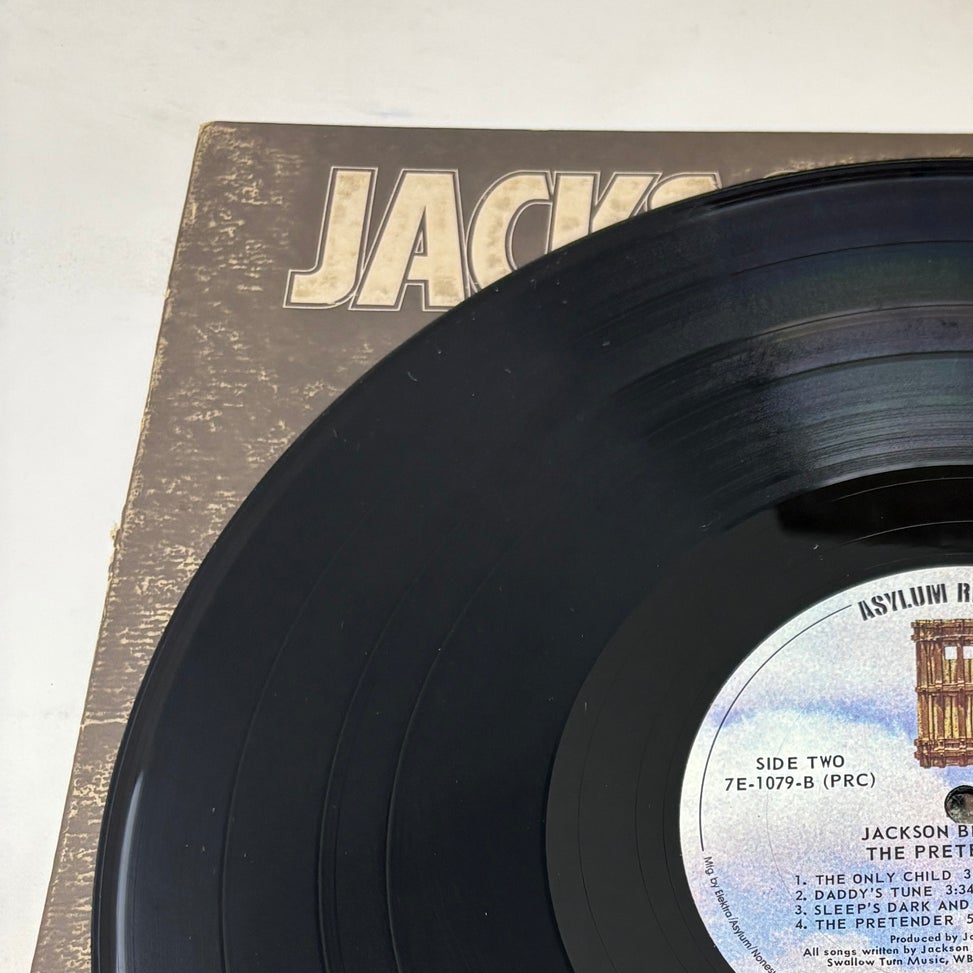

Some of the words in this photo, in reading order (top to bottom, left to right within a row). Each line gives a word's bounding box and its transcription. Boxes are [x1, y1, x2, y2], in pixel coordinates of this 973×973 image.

[858, 583, 948, 621] ASYLUM
[756, 757, 798, 770] SIDE
[807, 755, 845, 769] TWO
[725, 776, 814, 791] 7E-1079-B
[823, 772, 876, 790] (PRC)
[862, 825, 949, 841] JACKSON
[866, 846, 905, 861] THE
[710, 877, 720, 888] by
[795, 875, 807, 885] 1.
[816, 874, 846, 885] THE
[853, 872, 895, 884] ONLY
[903, 870, 951, 882] CHILD
[795, 891, 807, 901] 2.
[815, 888, 883, 900] DADDY'S
[891, 886, 933, 898] TUNE
[946, 884, 973, 895] 3:34
[795, 905, 807, 916] 3.
[814, 903, 881, 915] SLEEP'S
[888, 901, 930, 913] DARK
[938, 899, 969, 911] AND
[795, 919, 807, 930] 4.
[816, 919, 846, 930] THE
[856, 915, 953, 928] PRETENDER
[890, 933, 941, 943] Produced
[945, 933, 958, 943] by
[803, 948, 819, 957] All
[824, 949, 857, 958] songs
[862, 946, 899, 955] written
[904, 945, 917, 956] by
[921, 944, 969, 954] Jackson
[827, 957, 875, 967] Swallow
[879, 957, 902, 966] Turn
[907, 956, 949, 966] Music,
[953, 955, 973, 963] WB
